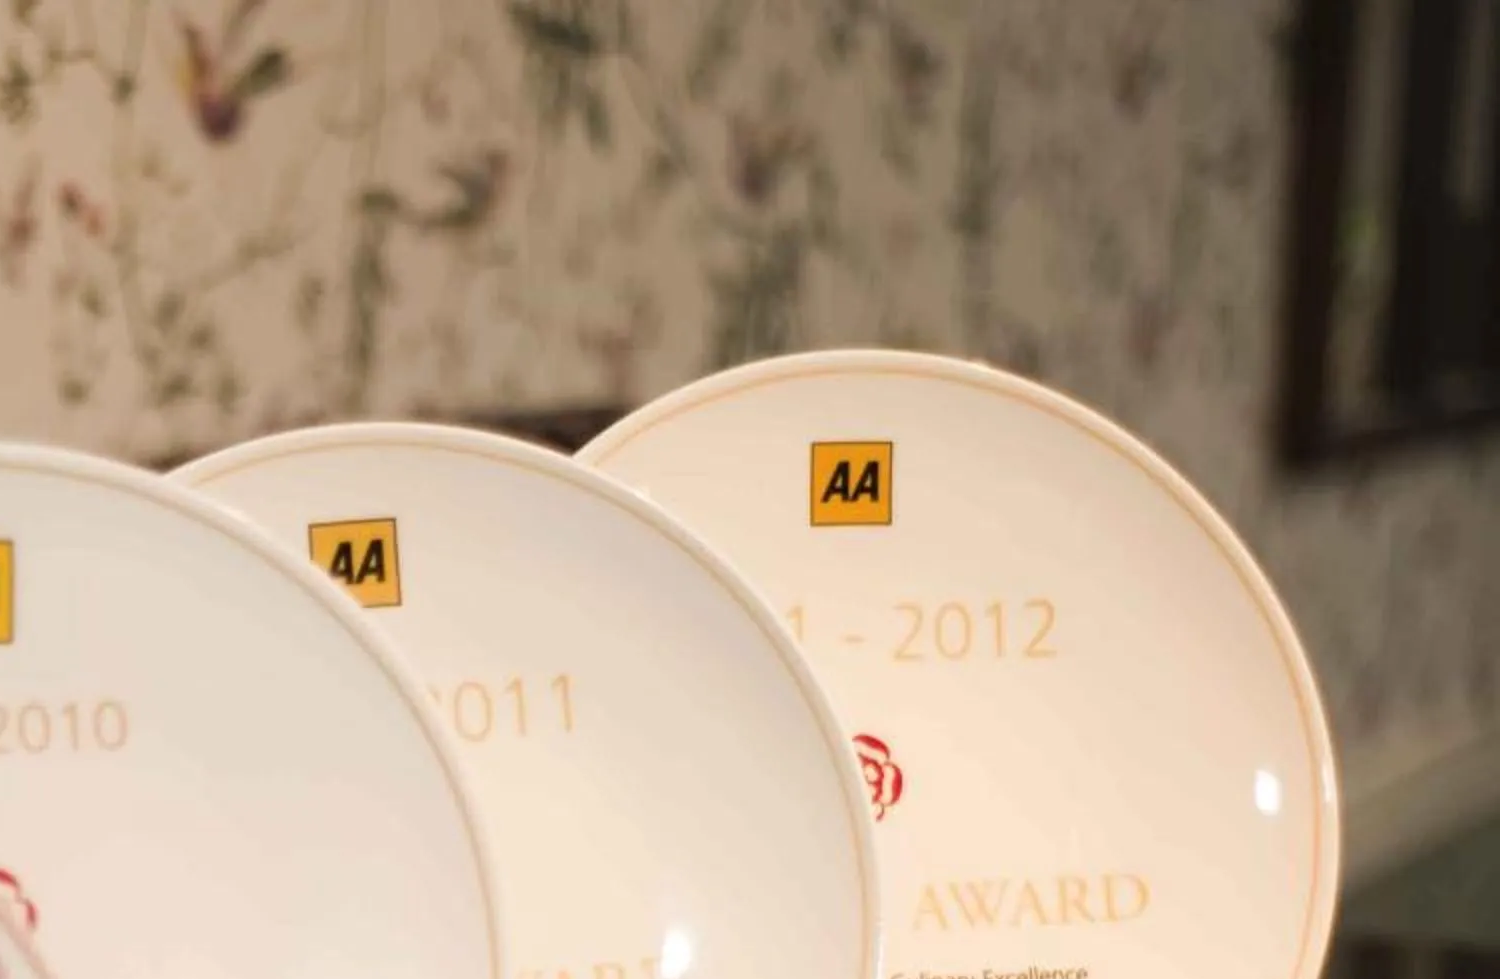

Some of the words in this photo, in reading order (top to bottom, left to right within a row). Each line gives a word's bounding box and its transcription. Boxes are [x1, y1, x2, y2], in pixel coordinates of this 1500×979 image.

[821, 461, 881, 503] AA
[328, 538, 387, 585] AA
[892, 598, 1060, 662] 2012
[426, 672, 576, 743] 011
[911, 871, 1152, 932] AWARD
